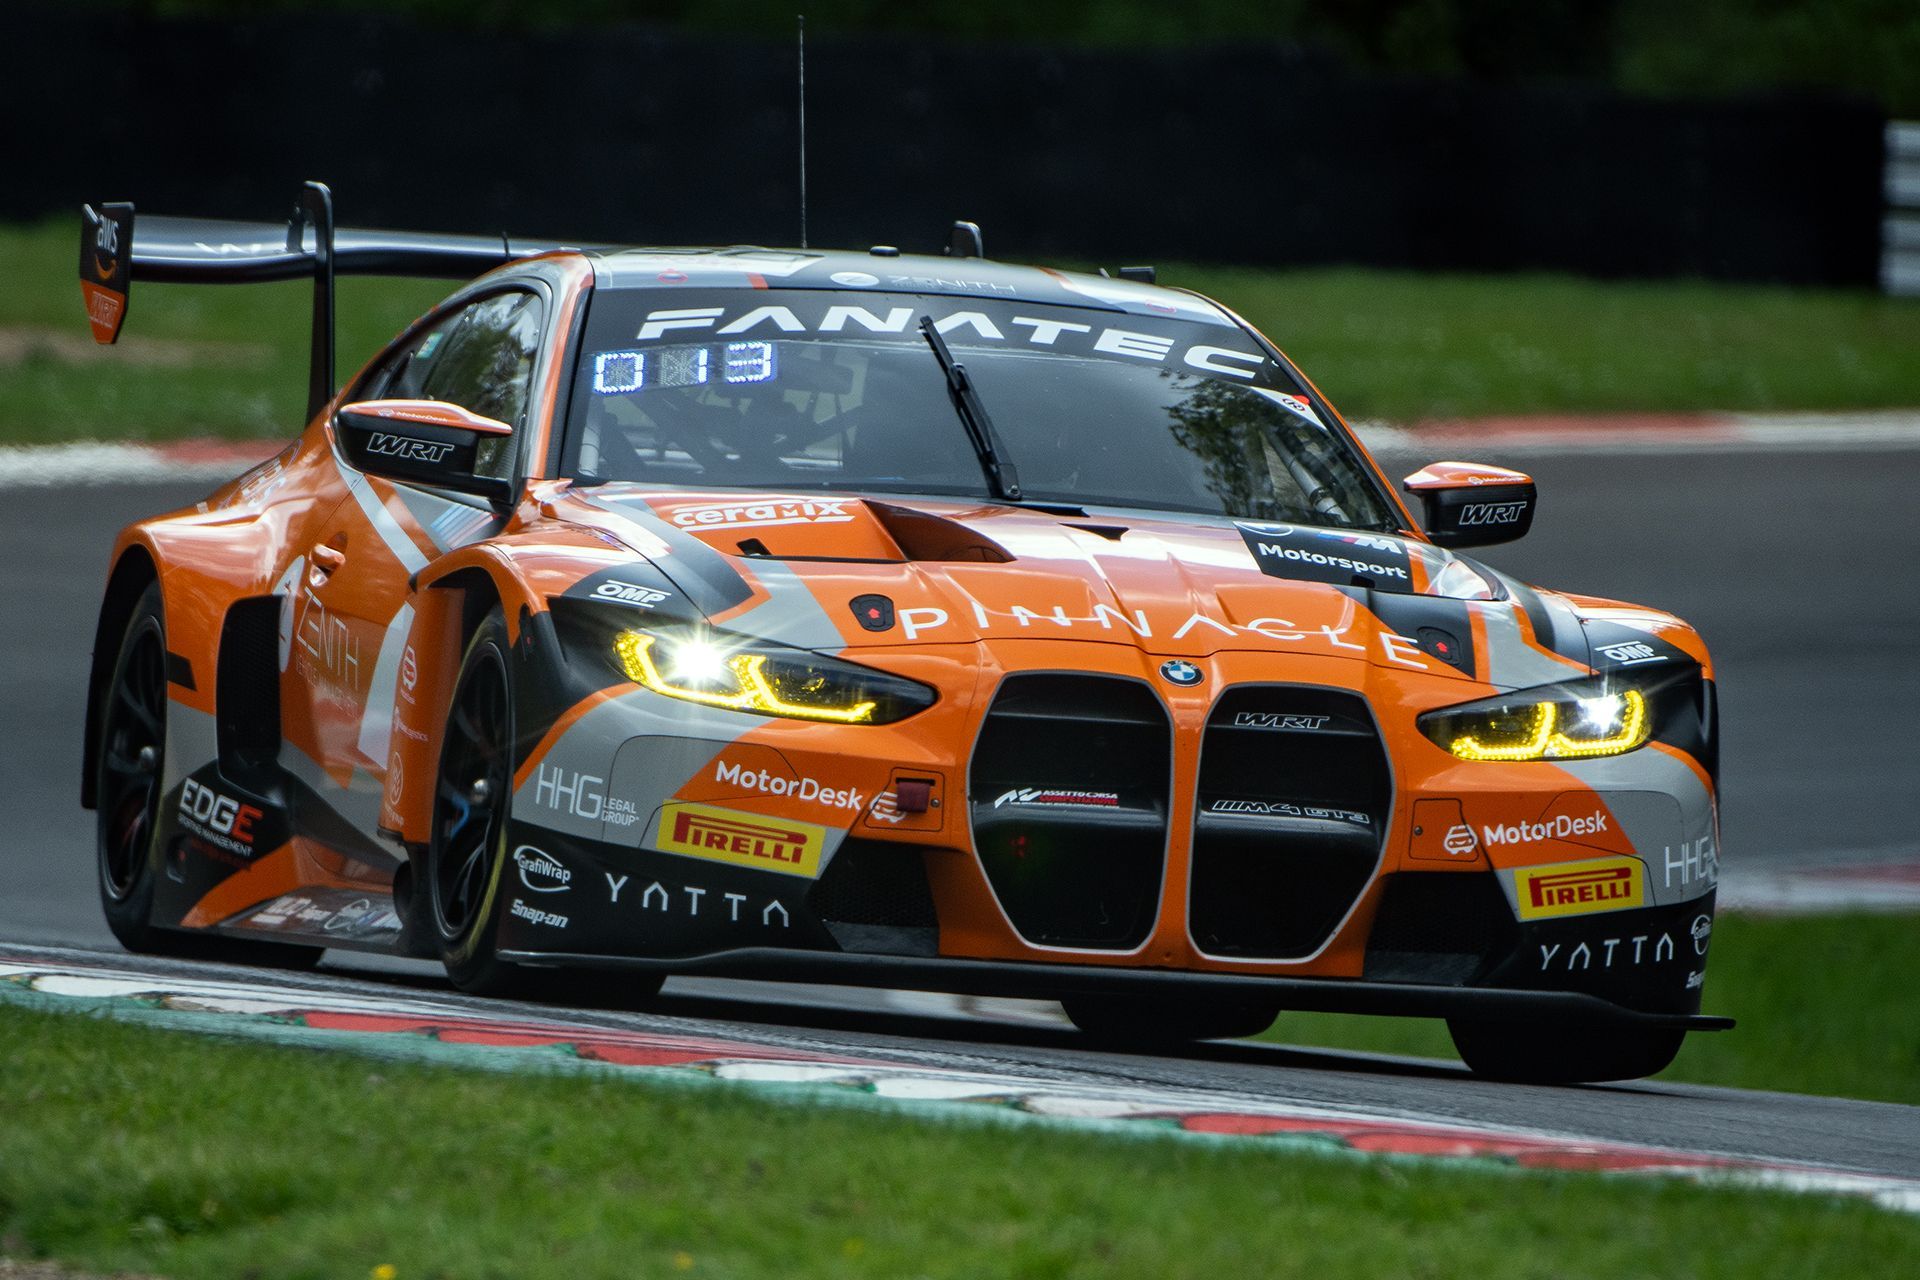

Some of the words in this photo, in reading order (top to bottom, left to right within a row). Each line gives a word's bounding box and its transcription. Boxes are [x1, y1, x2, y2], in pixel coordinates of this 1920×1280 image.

[97, 214, 119, 256] aws
[636, 305, 1265, 379] FANATEC
[366, 432, 455, 463] WRT
[1459, 501, 1528, 525] WRT
[1258, 543, 1408, 579] Motorsport
[596, 583, 666, 604] OMP
[297, 585, 360, 692] ZENITH
[897, 599, 1429, 669] PINNACLE
[1603, 643, 1656, 662] OMP
[1235, 712, 1330, 730] WRT
[535, 762, 604, 819] HHG
[715, 760, 862, 811] MotorDesk
[1042, 790, 1085, 798] ASSETTO
[1085, 791, 1118, 799] CORSA
[180, 777, 263, 843] EDGE
[601, 810, 637, 827] GROUP
[602, 797, 637, 814] LEGAL
[1304, 807, 1370, 824] GT3
[202, 828, 252, 857] MANAGEMENT
[672, 811, 808, 864] PIRELLI
[1483, 810, 1607, 848] MotorDesk
[518, 855, 571, 884] GrafiWrap
[1664, 836, 1709, 888] HHG
[605, 872, 790, 928] YATTA
[1528, 867, 1632, 908] PIRELLI
[511, 899, 569, 928] Snap-on
[1541, 932, 1674, 971] YATTA
